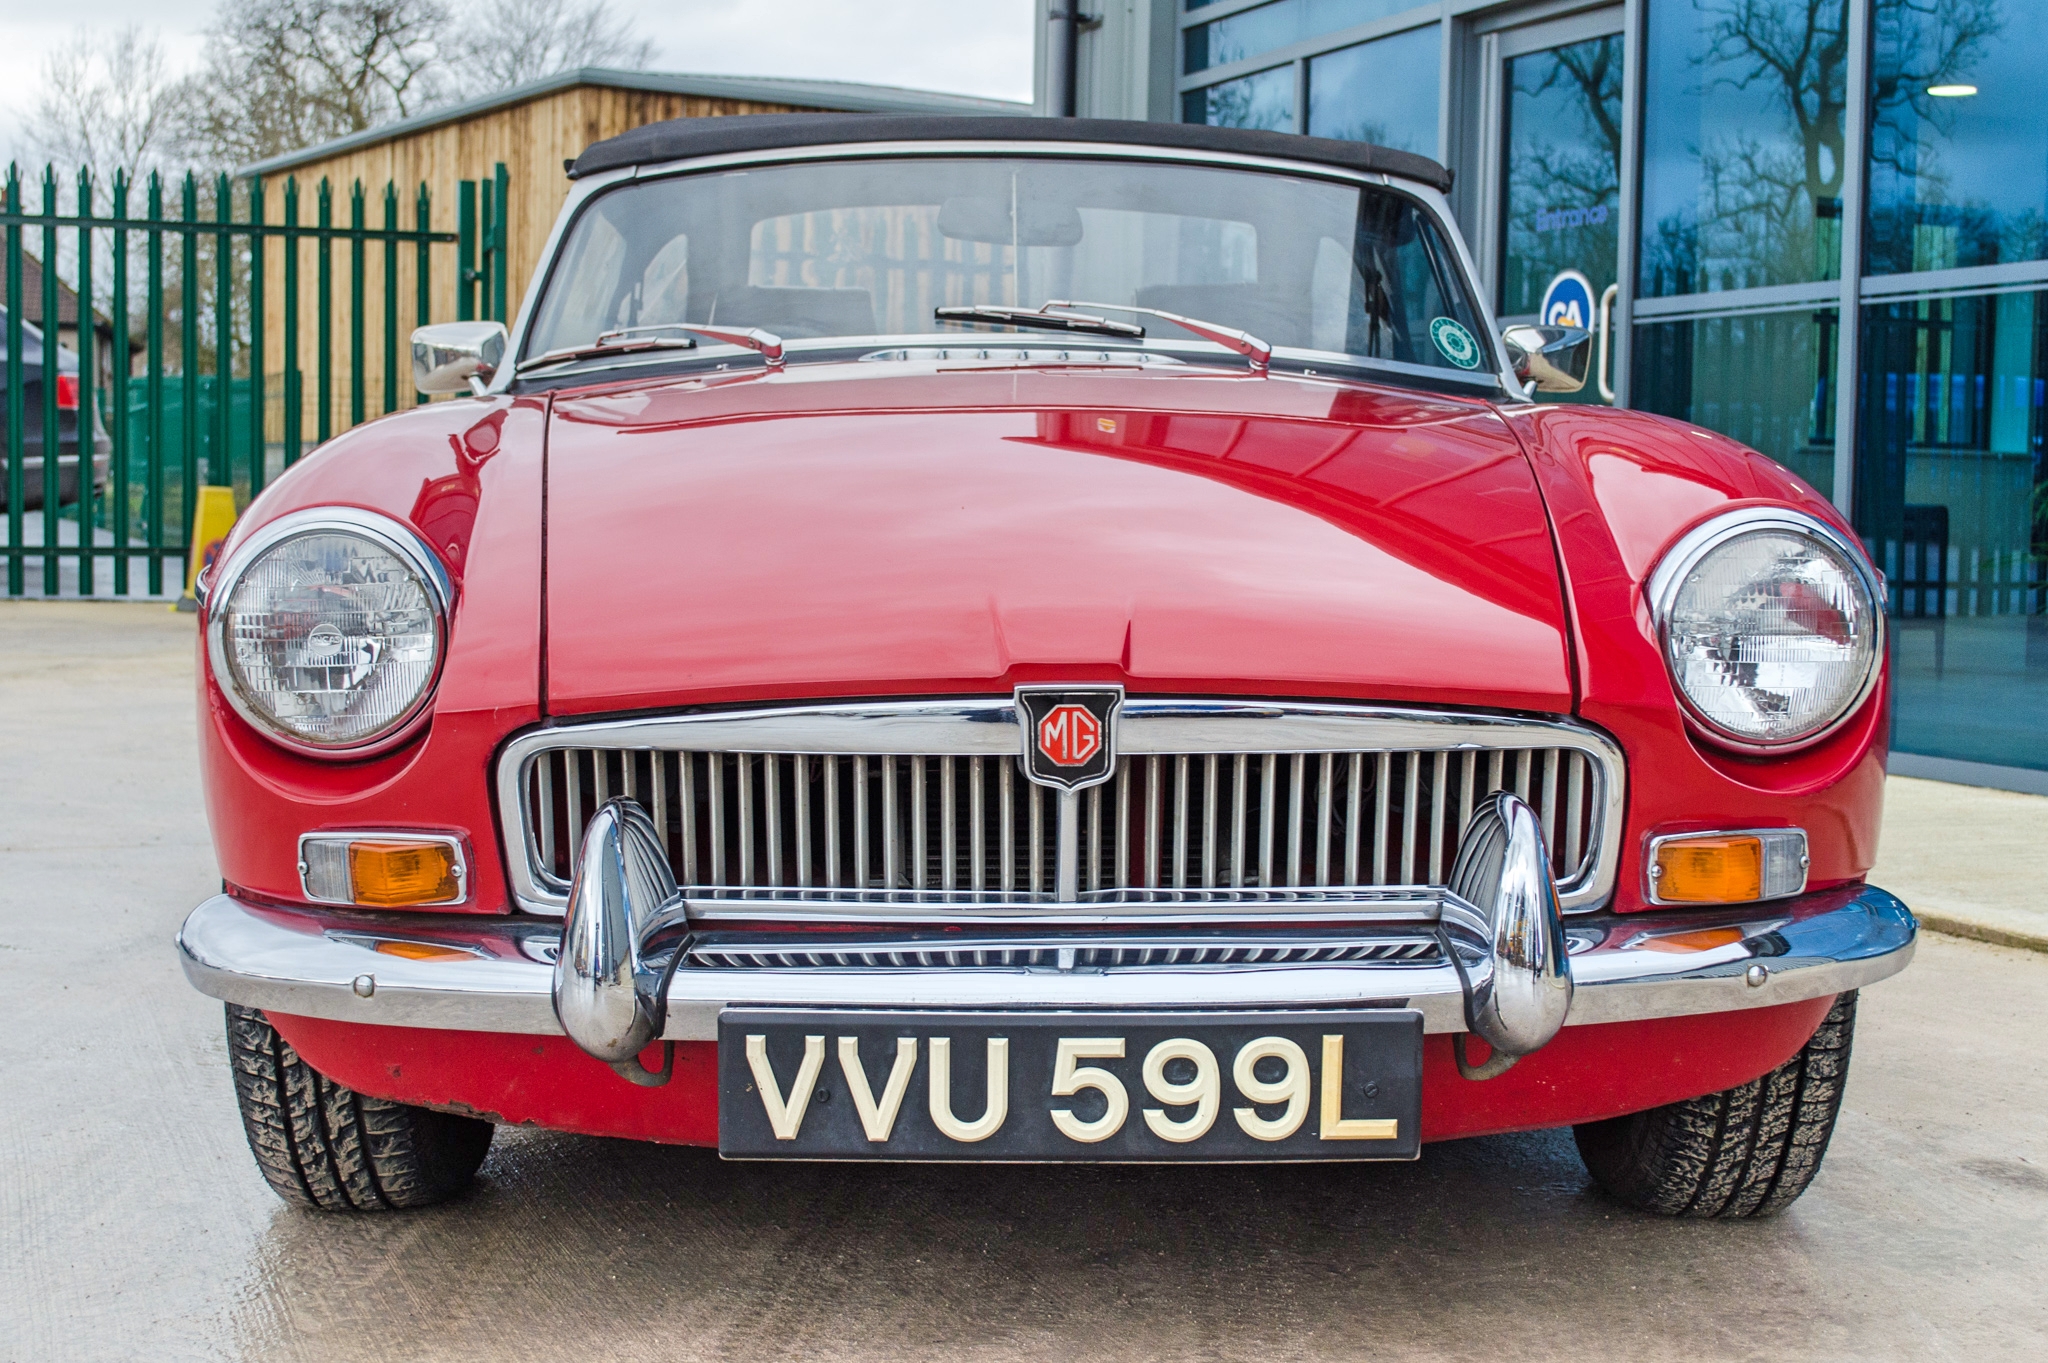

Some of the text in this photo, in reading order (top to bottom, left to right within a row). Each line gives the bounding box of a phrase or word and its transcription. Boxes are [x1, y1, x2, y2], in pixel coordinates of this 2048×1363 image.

[1044, 710, 1095, 760] MG
[746, 1034, 1398, 1143] VVU 599L
